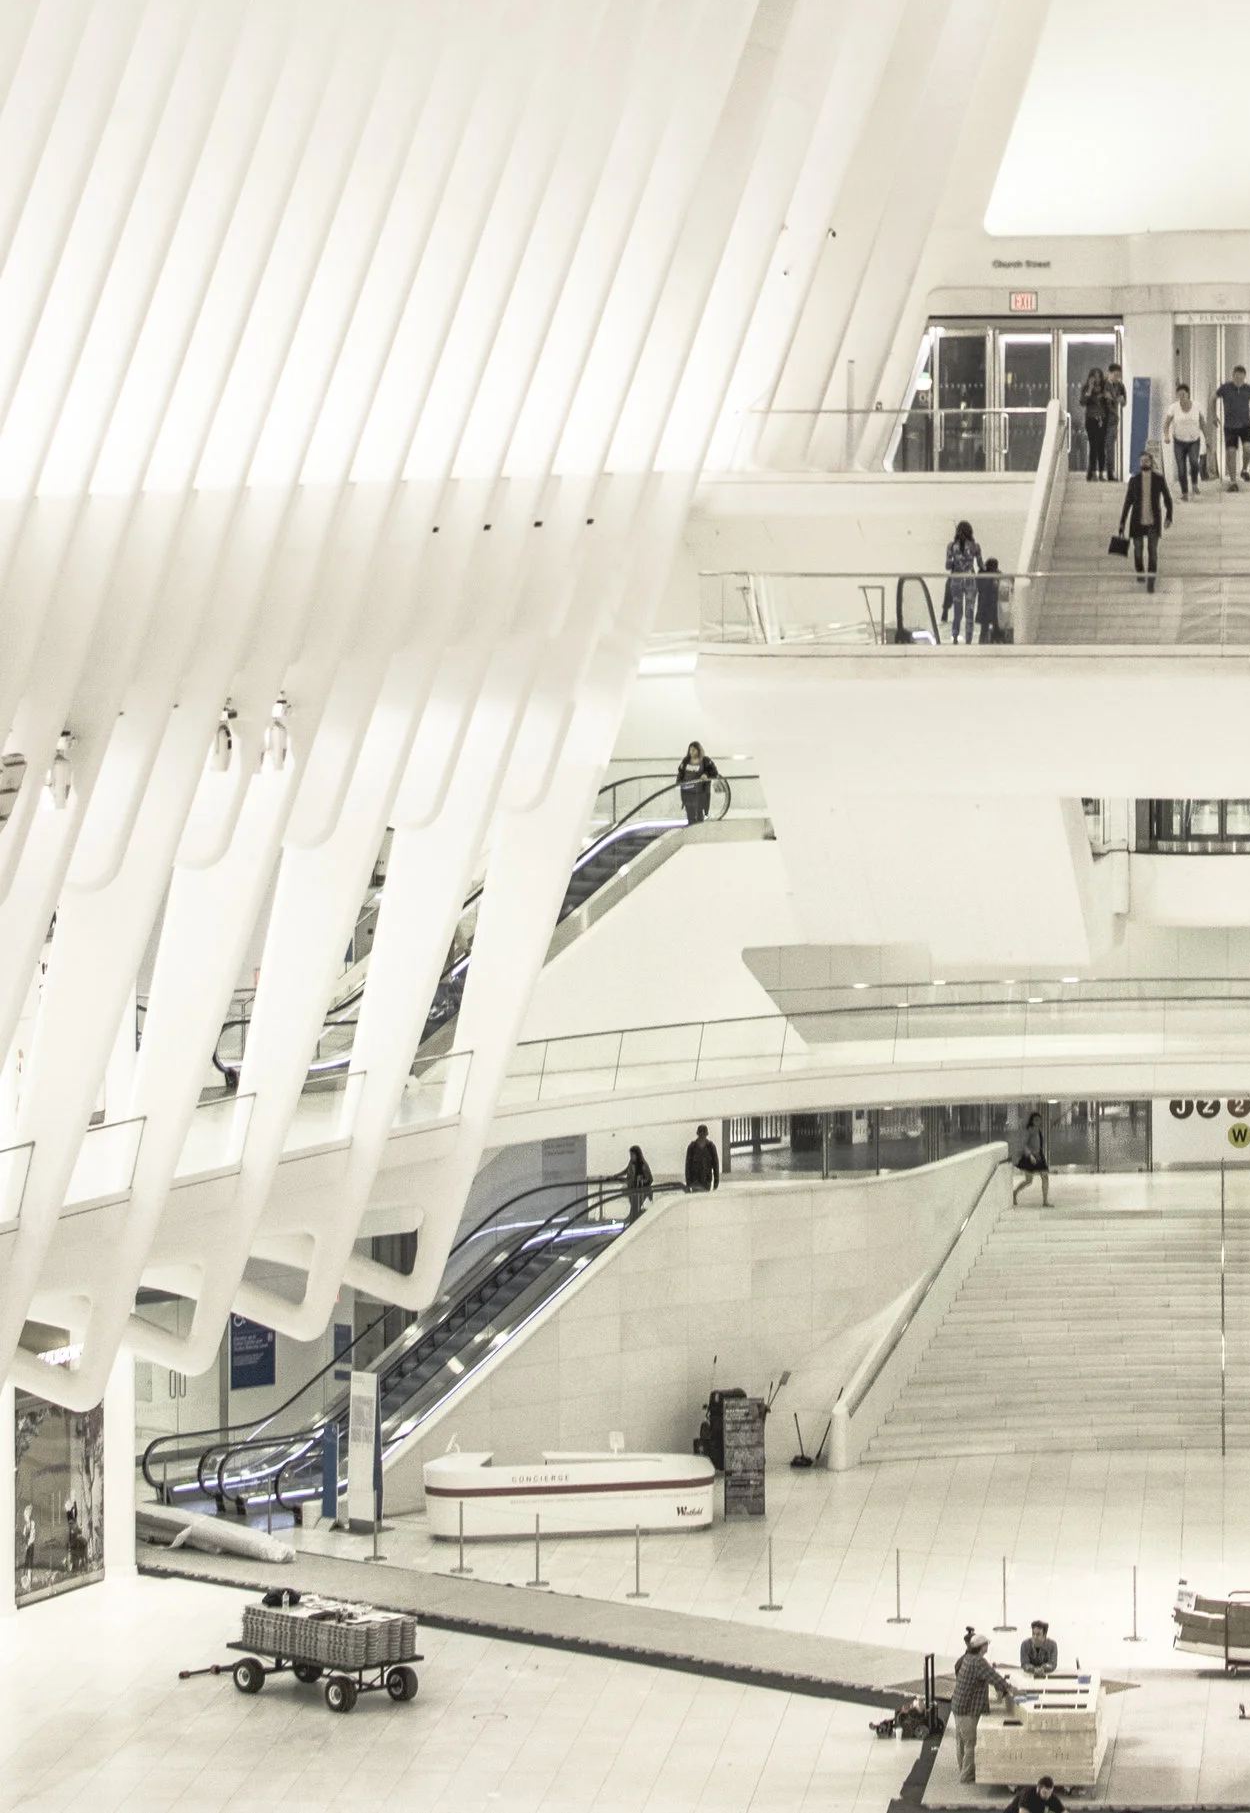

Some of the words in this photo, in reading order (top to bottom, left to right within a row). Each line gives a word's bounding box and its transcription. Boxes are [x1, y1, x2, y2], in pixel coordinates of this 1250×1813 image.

[992, 259, 1023, 268] Church
[1025, 259, 1051, 268] Street
[1013, 293, 1034, 310] EXIT
[1232, 1128, 1248, 1142] W
[511, 1475, 569, 1484] CONCIERGE
